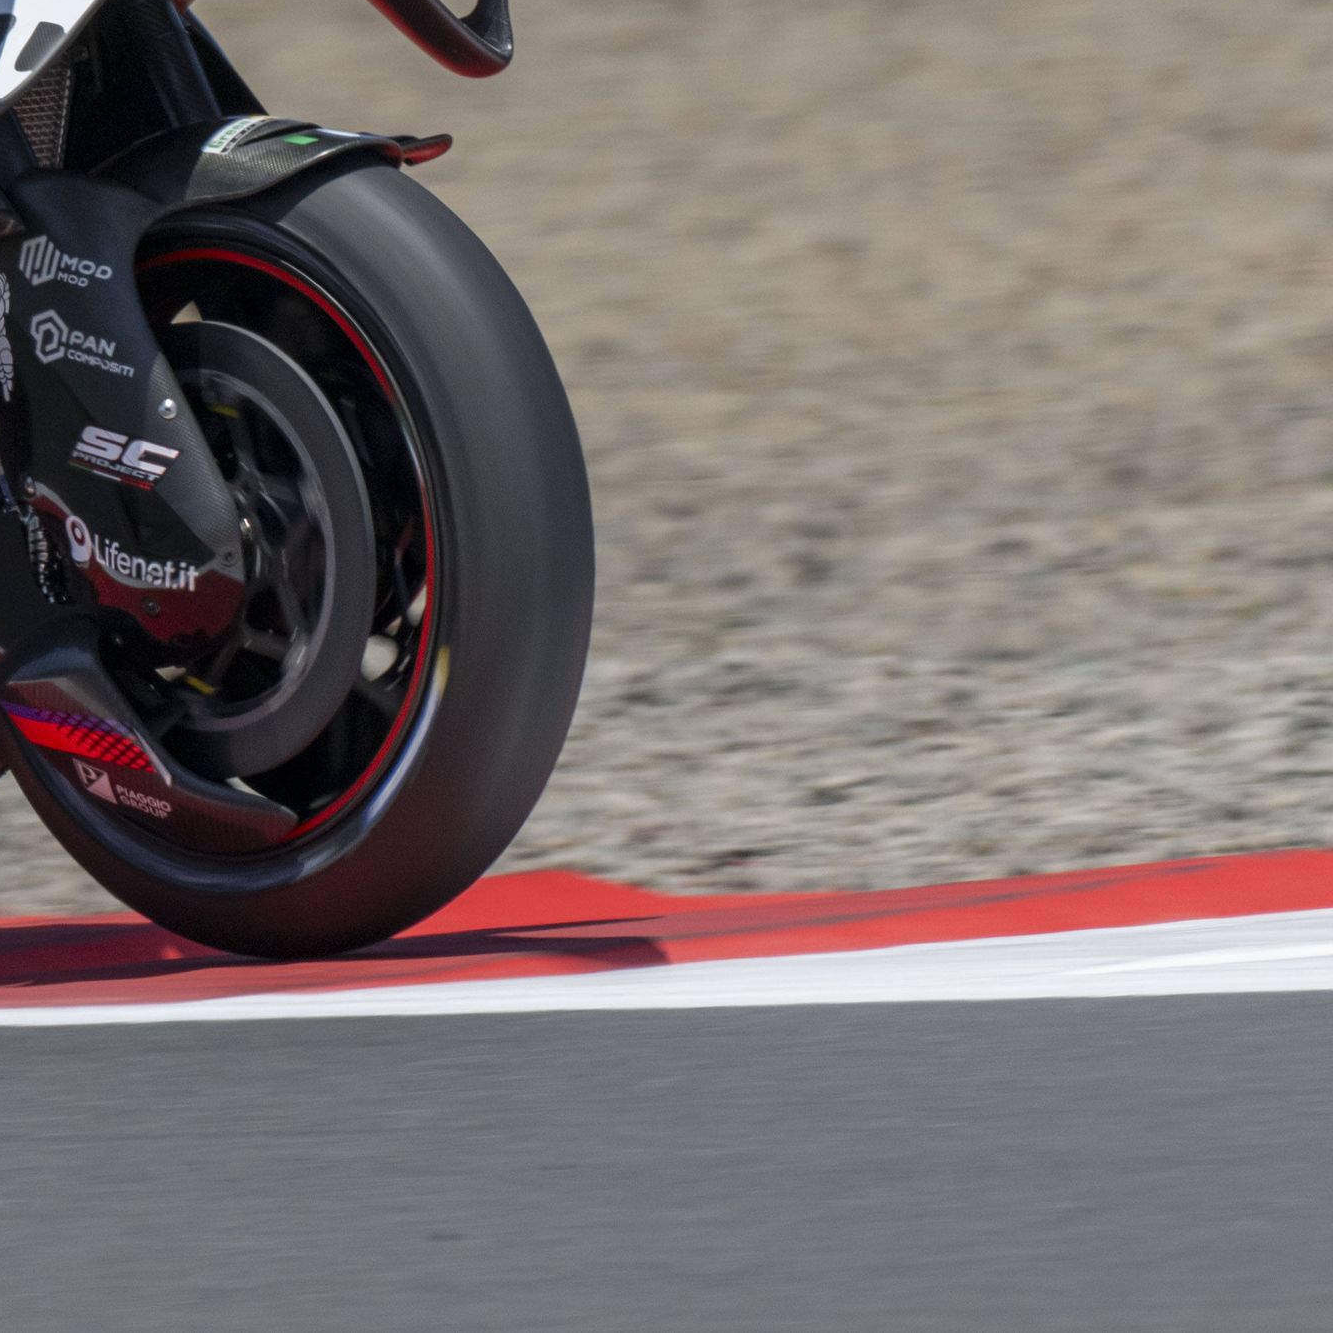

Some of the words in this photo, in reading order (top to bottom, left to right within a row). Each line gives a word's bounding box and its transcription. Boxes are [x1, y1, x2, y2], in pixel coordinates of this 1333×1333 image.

[56, 272, 89, 288] MOD
[59, 253, 113, 280] MOD
[69, 330, 117, 358] PAN
[75, 425, 180, 476] SC
[72, 450, 161, 482] PROJECT
[93, 533, 200, 592] Lifenet.it
[115, 783, 173, 814] PIAGGIO
[119, 795, 169, 820] GROUP
